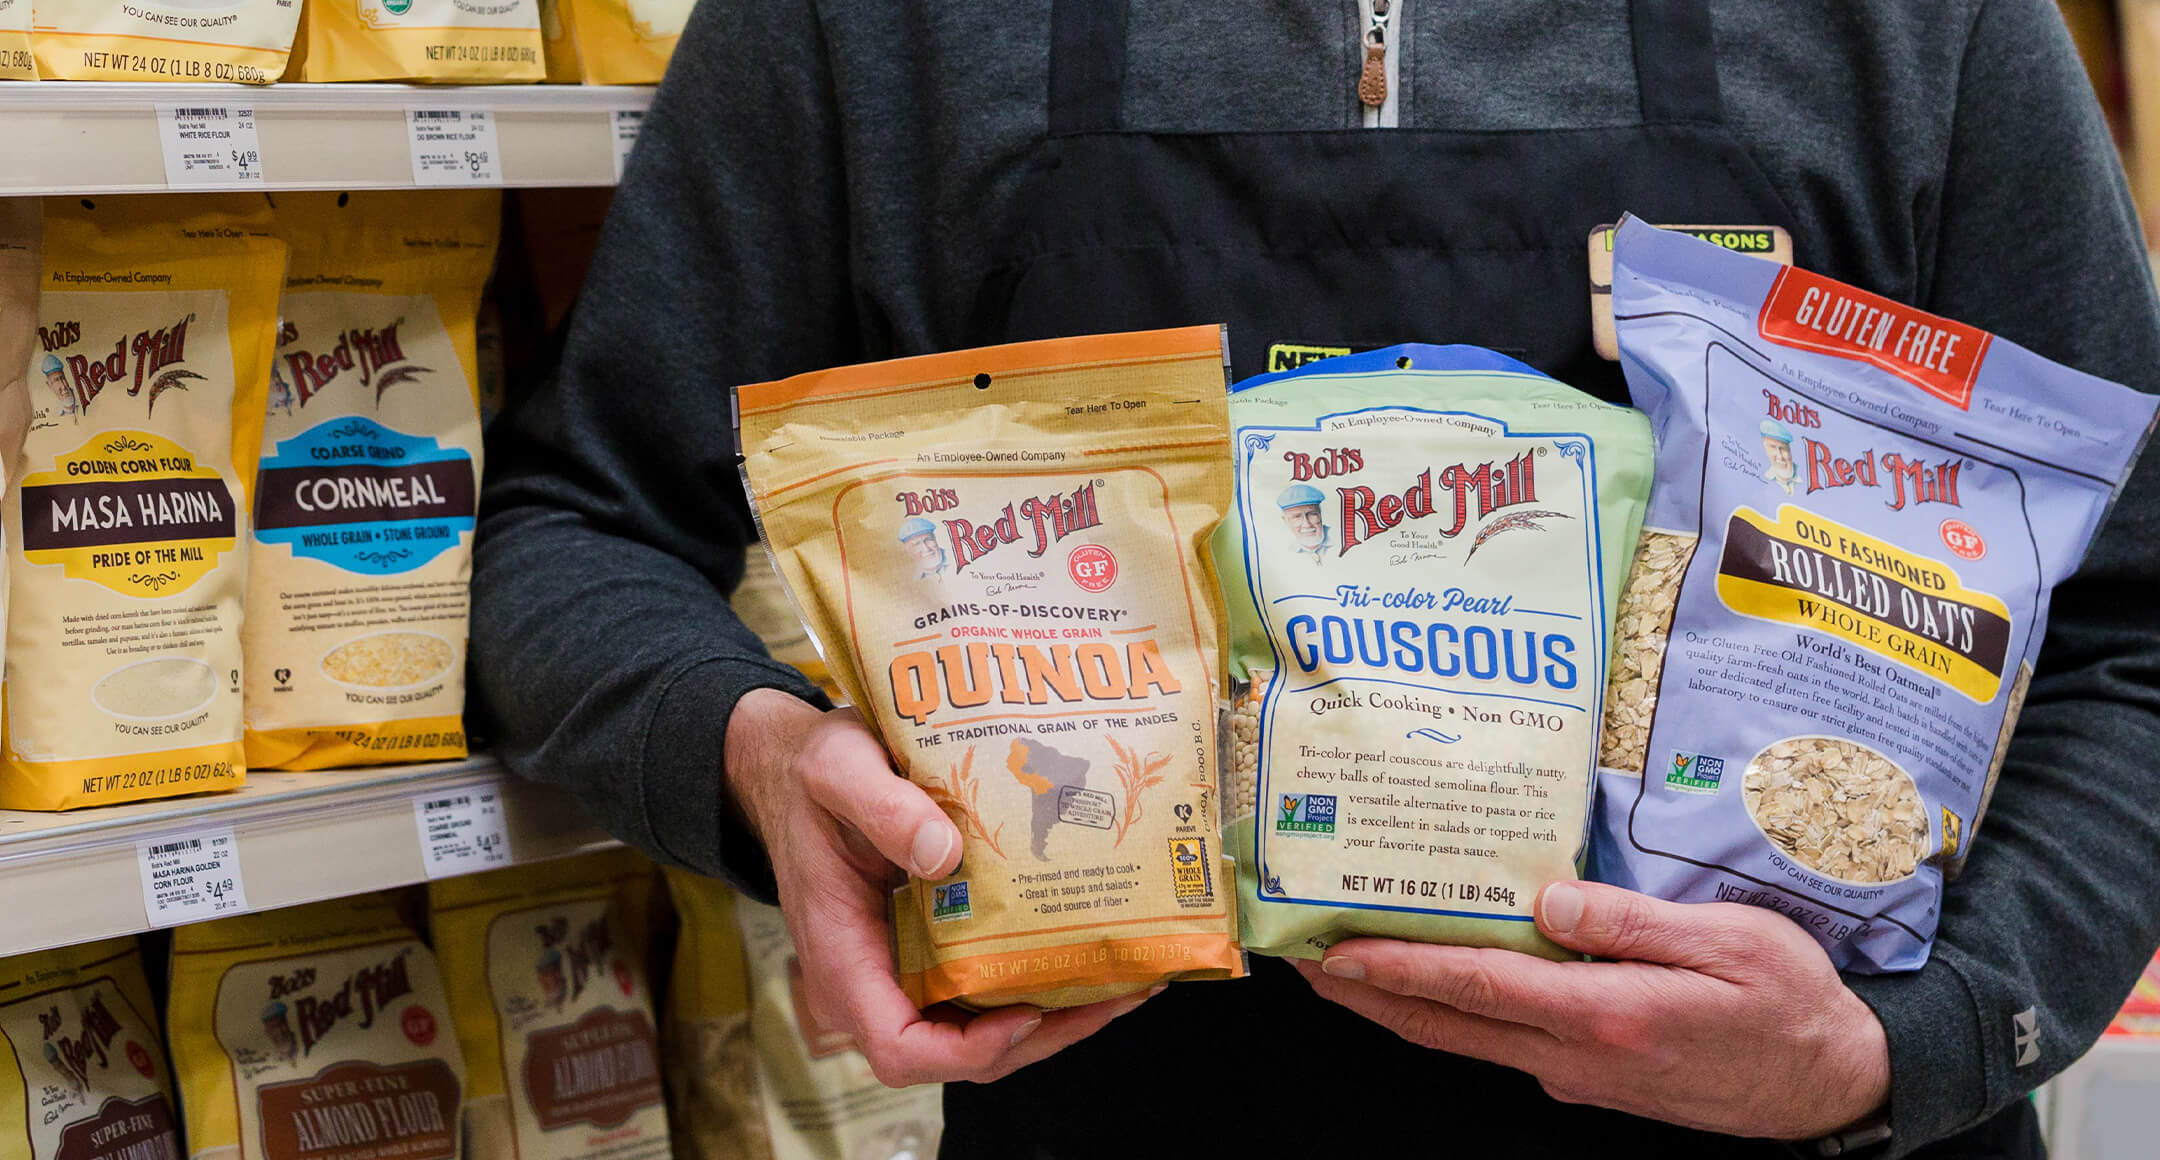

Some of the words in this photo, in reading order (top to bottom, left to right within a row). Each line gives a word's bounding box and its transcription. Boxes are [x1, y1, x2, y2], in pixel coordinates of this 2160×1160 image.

[122, 4, 144, 22] YOU
[145, 11, 162, 24] CAN
[164, 15, 179, 26] SEE
[181, 16, 198, 28] OUR
[84, 52, 107, 69] NET
[112, 53, 130, 71] WT
[132, 55, 147, 72] 24
[151, 57, 166, 73] OZ
[170, 59, 182, 77] (1
[185, 60, 201, 77] LB
[204, 61, 212, 78] 8
[215, 62, 235, 81] OZ)
[238, 65, 266, 84] 680g
[180, 131, 197, 140] WHITE
[198, 131, 211, 140] RICE
[212, 131, 231, 139] FLOUR
[1794, 286, 1898, 352] GLUTEN
[1893, 319, 1963, 376] FREE
[66, 334, 128, 416] Red
[284, 330, 355, 408] Red
[1275, 350, 1343, 371] NE
[1762, 388, 1822, 430] Bob's
[1331, 421, 1345, 432] An
[1347, 413, 1443, 427] Employee-Owned
[1446, 414, 1497, 438] Company
[67, 460, 118, 477] GOLDEN
[120, 460, 158, 474] CORN
[161, 458, 193, 473] FLOUR
[311, 444, 364, 460] COARSE
[367, 444, 406, 460] GRIND
[917, 452, 930, 463] An
[933, 450, 1019, 465] Employee-Owned
[1021, 450, 1066, 463] Company
[1284, 447, 1365, 481] Bob's
[1802, 436, 1881, 495] Red
[295, 474, 447, 512] CORNMEAL
[895, 487, 960, 518] Bob's
[51, 495, 133, 533] MASA
[137, 490, 224, 527] HARINA
[1336, 466, 1438, 558] Red
[302, 531, 339, 548] WHOLE
[341, 529, 374, 544] GRAIN
[383, 526, 413, 542] STONE
[414, 525, 451, 540] GROUND
[942, 500, 1024, 576] Red
[92, 552, 131, 569] PRIDE
[135, 551, 152, 565] OF
[154, 549, 177, 564] THE
[180, 546, 204, 562] MILL
[1075, 560, 1109, 578] GF
[1796, 519, 1833, 549] OLD
[1839, 536, 1947, 592] FASHIONED
[1336, 584, 1439, 611] Tri-color
[1442, 587, 1514, 617] Pearl
[1768, 538, 1892, 620] ROLLED
[1901, 585, 1977, 655] OATS
[951, 626, 1008, 640] ORGANIC
[1011, 628, 1058, 640] WHOLE
[1062, 626, 1103, 640] GRAIN
[1796, 598, 1882, 645] WHOLE
[1887, 632, 1953, 676] GRAIN
[1286, 613, 1579, 692] COUSCOUS
[1796, 633, 1851, 663] World's
[1854, 652, 1882, 676] Best
[889, 638, 1183, 727] QUINOA
[1686, 649, 1725, 666] quality
[1727, 653, 1784, 677] farm-fresh
[1786, 669, 1809, 683] oats
[1811, 675, 1822, 686] in
[1823, 679, 1840, 693] the
[1310, 690, 1363, 716] Quick
[1368, 691, 1443, 720] Cooking
[1462, 705, 1503, 725] Non
[1509, 709, 1565, 733] GMO
[115, 722, 131, 735] YOU
[132, 726, 150, 736] CAN
[151, 725, 163, 736] SEE
[164, 723, 179, 735] OUR
[915, 736, 942, 750] THE
[947, 723, 1033, 744] TRADITIONAL
[1037, 719, 1077, 735] GRAIN
[1082, 717, 1099, 730] OF
[1104, 716, 1130, 729] THE
[1134, 711, 1179, 728] ANDES
[1298, 745, 1353, 761] Tri-color
[1355, 749, 1387, 766] pearl
[1389, 755, 1443, 768] couscous
[1445, 759, 1465, 769] are
[1467, 760, 1533, 778] delightfully
[1536, 765, 1568, 781] nutty,
[1697, 765, 1721, 776] GMO
[1699, 757, 1723, 768] NON
[1296, 767, 1336, 783] chewy
[1339, 768, 1368, 782] balls
[1371, 771, 1387, 784] of
[1388, 773, 1431, 789] toasted
[1433, 778, 1488, 794] semolina
[1490, 780, 1521, 796] flour.
[1523, 784, 1549, 800] This
[1308, 805, 1335, 815] GMO
[1309, 796, 1335, 806] NON
[1349, 793, 1401, 808] versatile
[1403, 796, 1468, 813] alternative
[1471, 802, 1483, 815] to
[1486, 805, 1516, 819] pasta
[1519, 807, 1533, 818] or
[1535, 807, 1556, 821] rice
[1279, 821, 1334, 833] VERIFIED
[1347, 814, 1358, 826] is
[1360, 814, 1416, 830] excellent
[1418, 818, 1431, 831] in
[1433, 820, 1471, 836] salads
[1473, 825, 1487, 836] or
[1489, 826, 1531, 842] topped
[1532, 827, 1558, 843] with
[1344, 837, 1376, 850] your
[1378, 836, 1426, 854] favorite
[1428, 842, 1461, 857] pasta
[1463, 846, 1500, 859] sauce.
[152, 869, 171, 879] MASA
[171, 867, 195, 877] HARINA
[196, 861, 221, 872] GOLDEN
[153, 880, 172, 890] CORN
[173, 876, 194, 886] FLOUR
[1342, 874, 1369, 893] NET
[1373, 877, 1396, 895] WT
[1399, 879, 1417, 898] 16
[1420, 881, 1439, 899] OZ
[1441, 882, 1456, 901] (1
[1459, 883, 1481, 902] LB)
[1484, 885, 1517, 907] 454g
[291, 1101, 378, 1152] ALMOND
[376, 1090, 445, 1139] FLOUR
